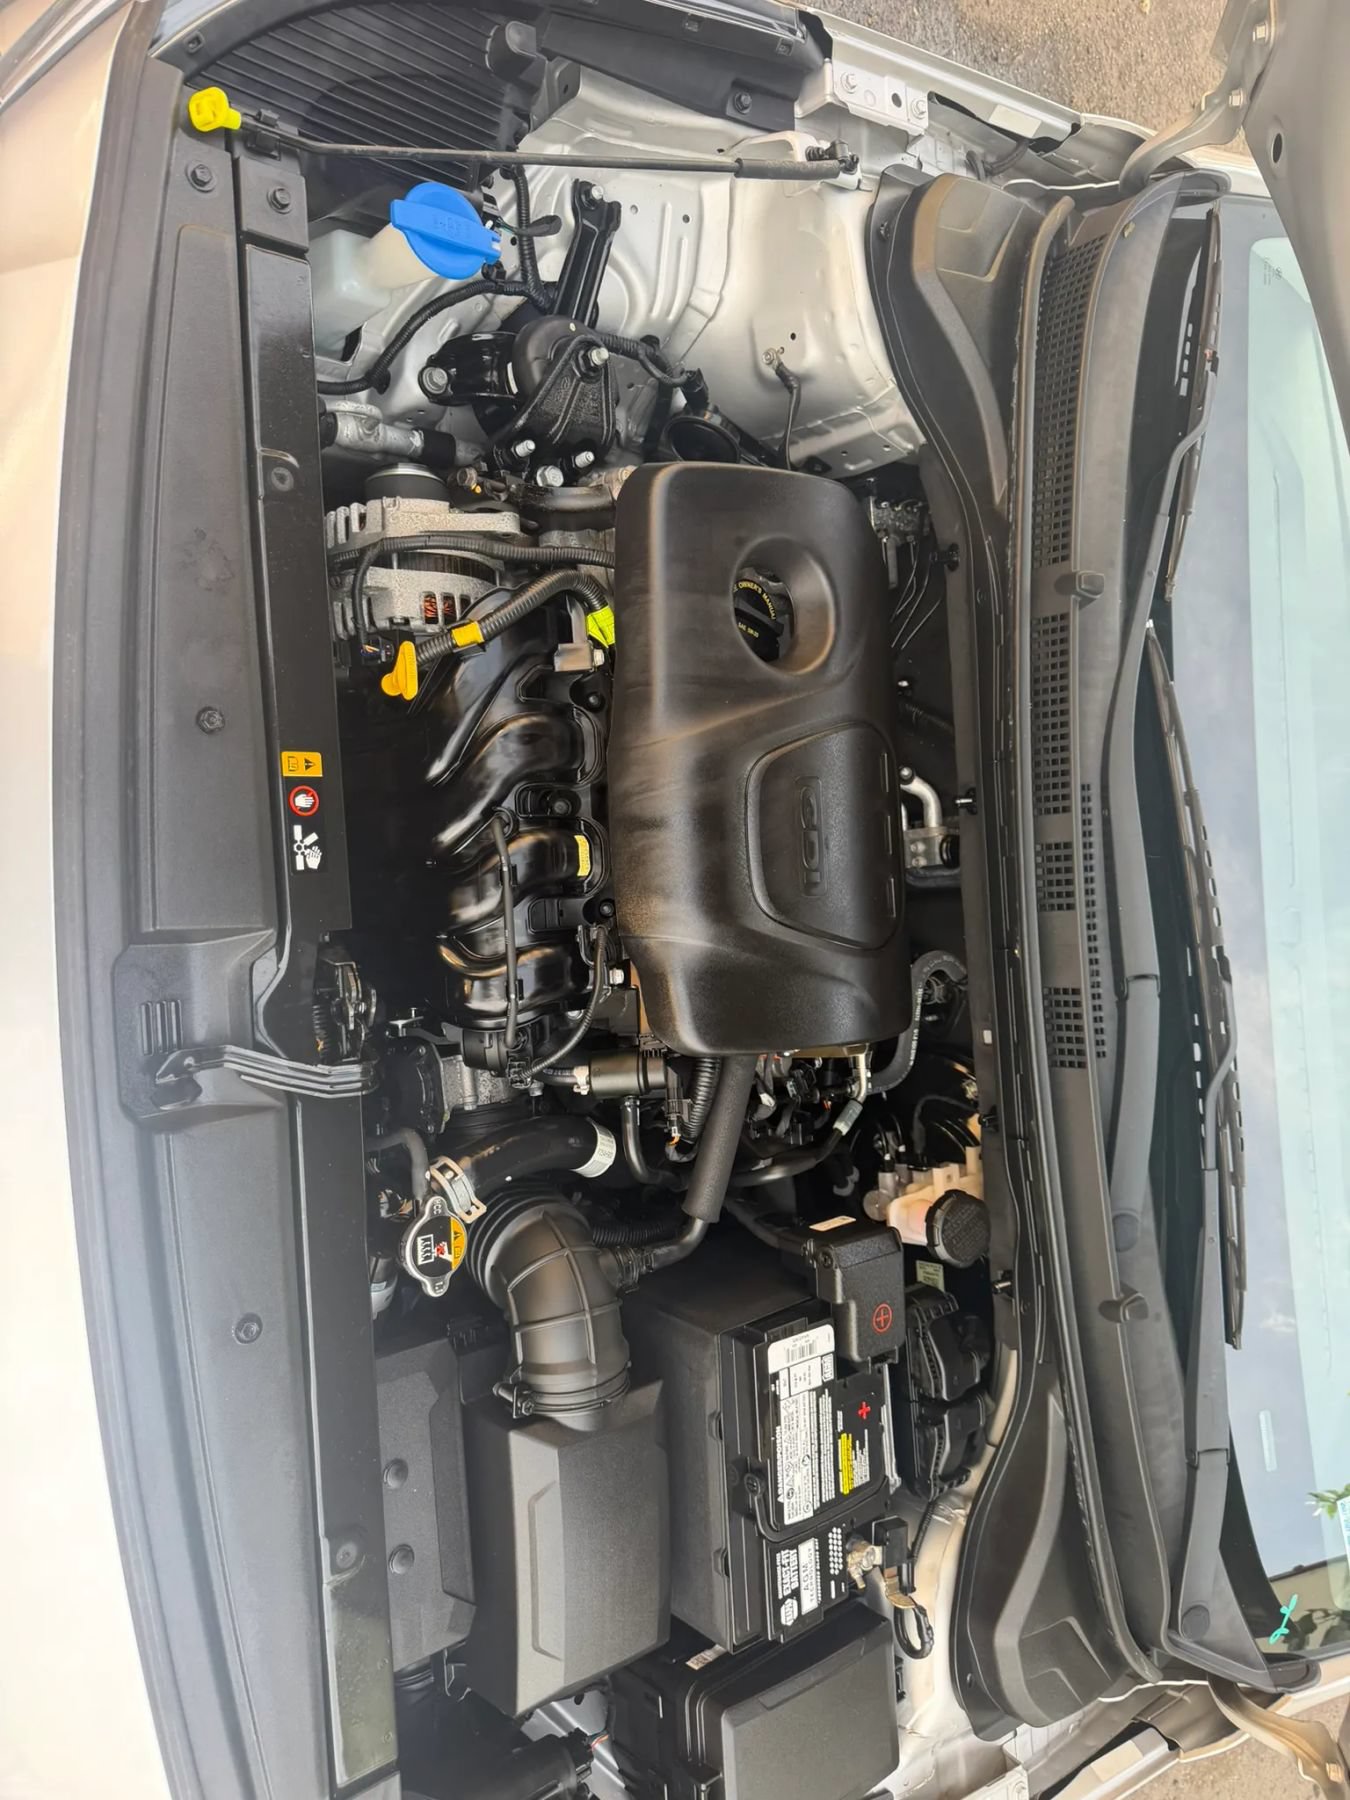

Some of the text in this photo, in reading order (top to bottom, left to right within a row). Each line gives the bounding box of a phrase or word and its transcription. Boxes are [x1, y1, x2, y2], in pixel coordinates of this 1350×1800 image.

[801, 787, 821, 882] GDI
[781, 1549, 792, 1597] EXACT-FIT
[790, 1549, 799, 1590] BATTERY
